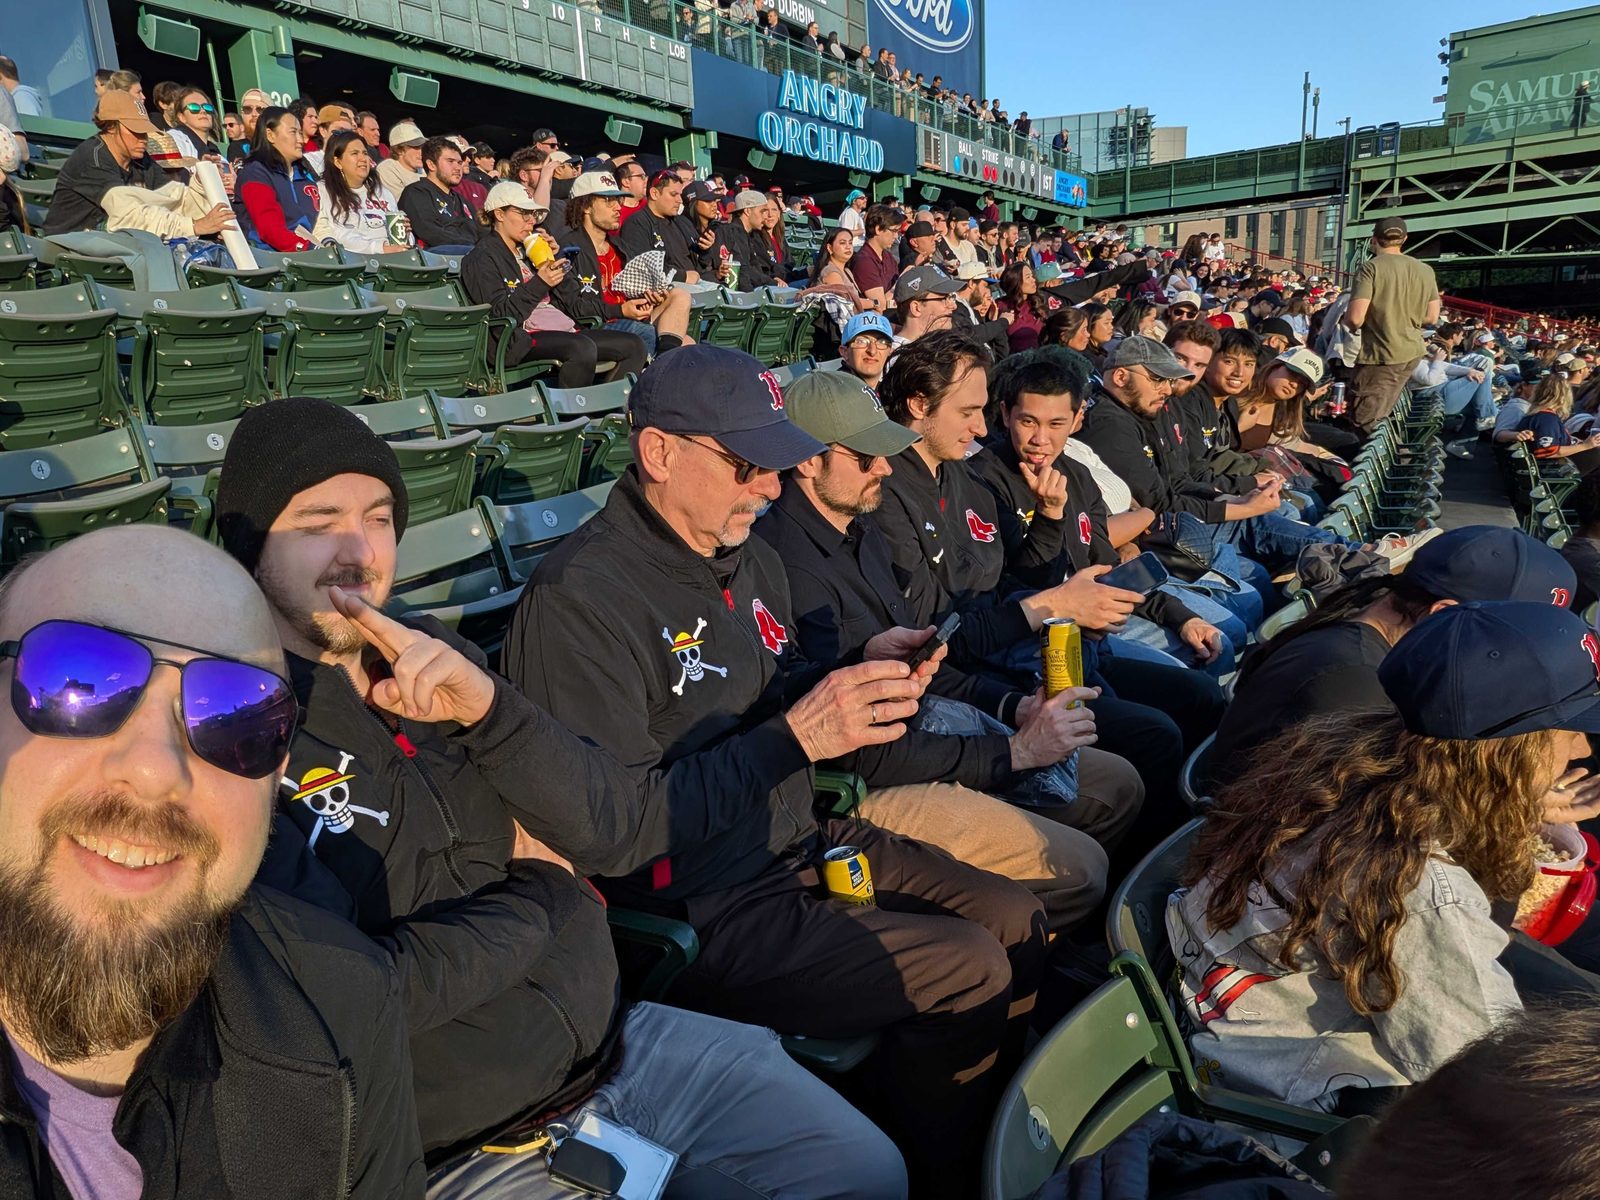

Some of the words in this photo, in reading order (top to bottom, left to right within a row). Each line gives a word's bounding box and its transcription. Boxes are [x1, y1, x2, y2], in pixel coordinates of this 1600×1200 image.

[779, 0, 815, 25] DURBIN
[889, 0, 953, 36] ord
[552, 3, 565, 20] 10
[595, 17, 602, 32] R
[623, 26, 630, 42] H
[650, 36, 656, 49] E
[669, 42, 686, 59] LOB
[779, 70, 867, 130] ANGRY
[759, 111, 884, 173] ORCHARD
[958, 140, 974, 157] BALL
[981, 148, 999, 165] STRIKE
[1004, 156, 1014, 169] OUT
[396, 222, 406, 239] B
[863, 315, 878, 325] M
[211, 436, 219, 447] 5
[37, 463, 45, 475] 4
[1391, 536, 1408, 550] N
[1032, 1117, 1044, 1140] 2
